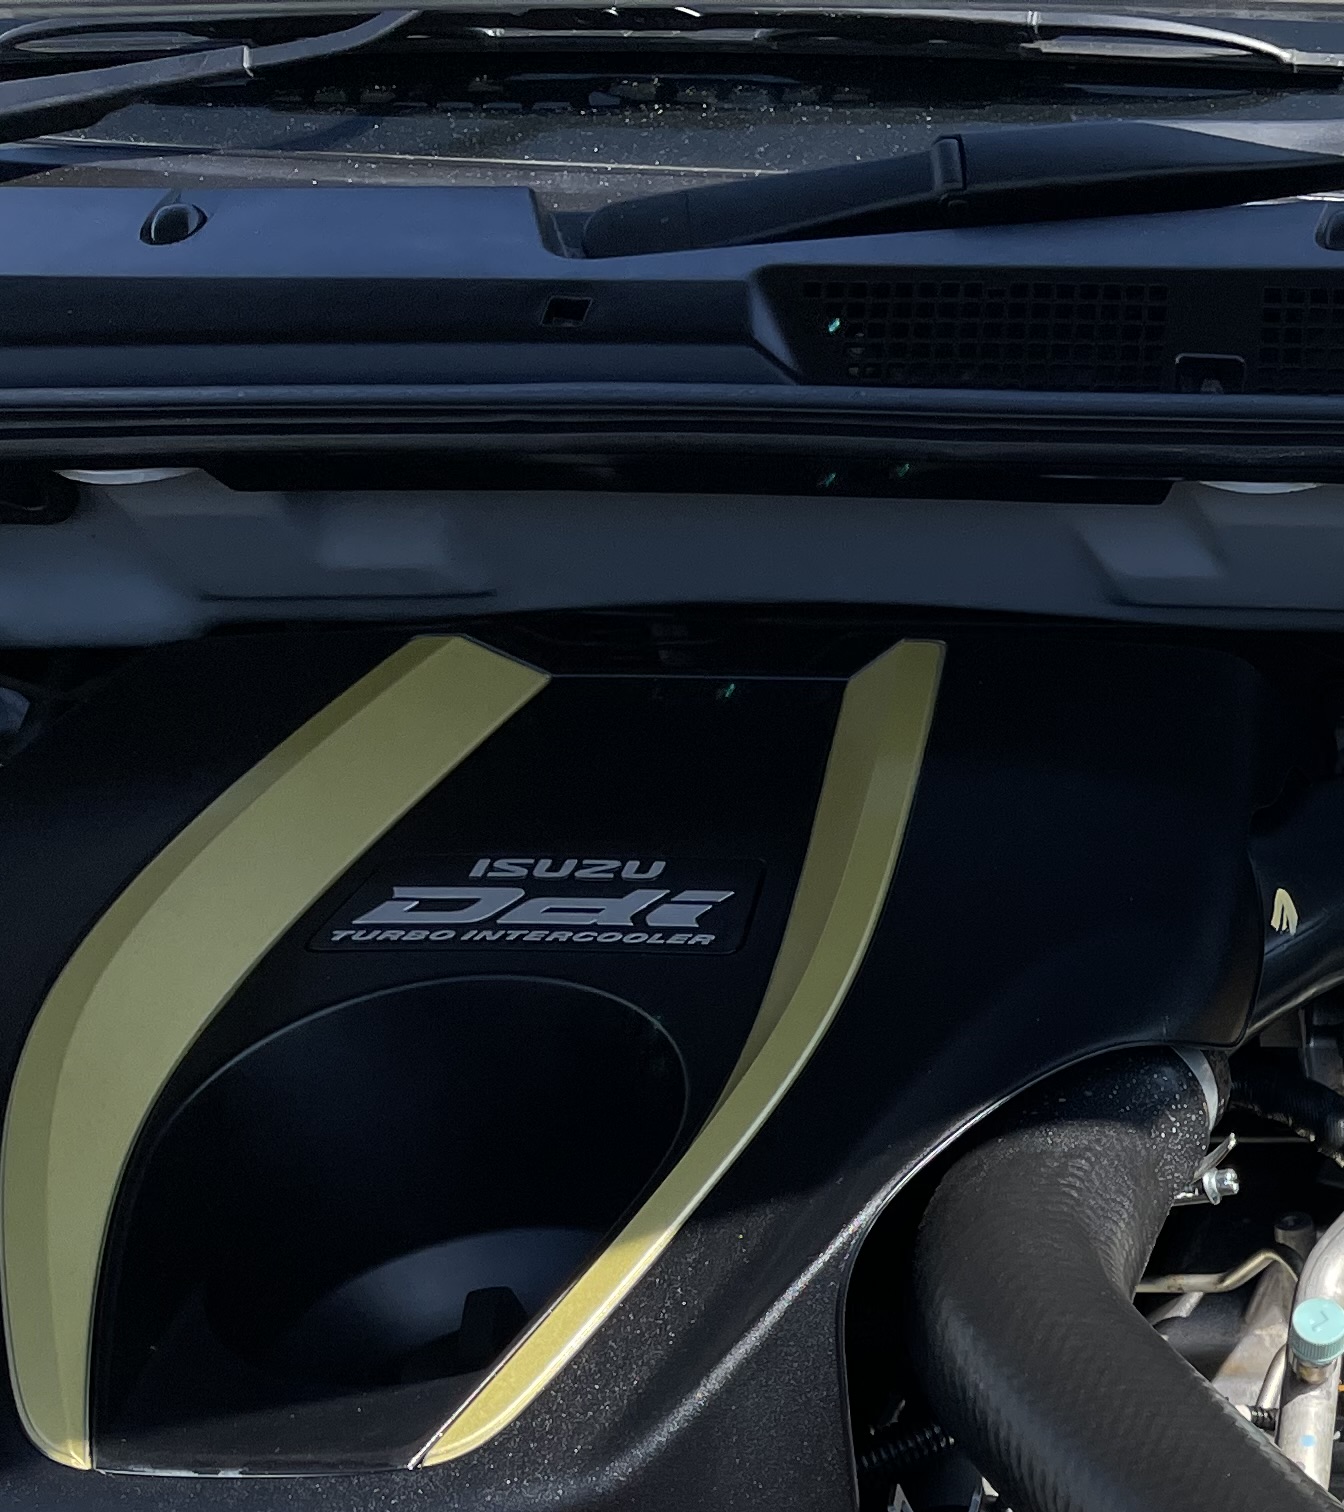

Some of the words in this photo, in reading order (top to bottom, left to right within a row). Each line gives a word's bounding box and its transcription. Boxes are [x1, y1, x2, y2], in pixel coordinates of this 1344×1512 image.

[469, 858, 666, 880] ISUZU
[331, 929, 455, 941] TURBO
[460, 929, 716, 946] INTERCOOLER
